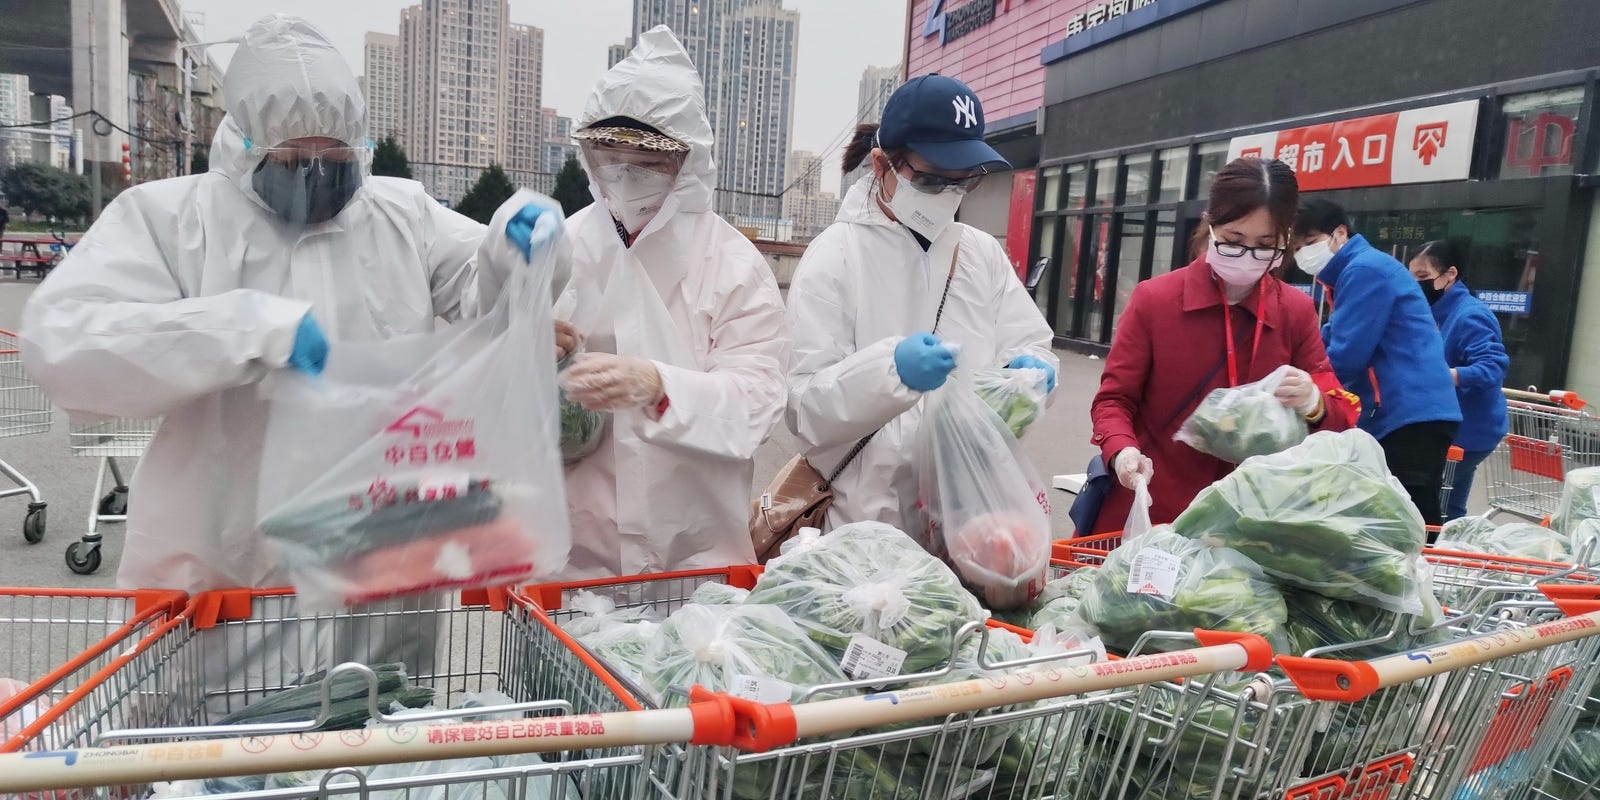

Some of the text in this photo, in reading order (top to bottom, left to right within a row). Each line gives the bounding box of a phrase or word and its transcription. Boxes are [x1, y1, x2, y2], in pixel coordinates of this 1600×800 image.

[1279, 133, 1388, 174] 超市入口
[427, 722, 605, 744] 请保管好自己的贵重物品
